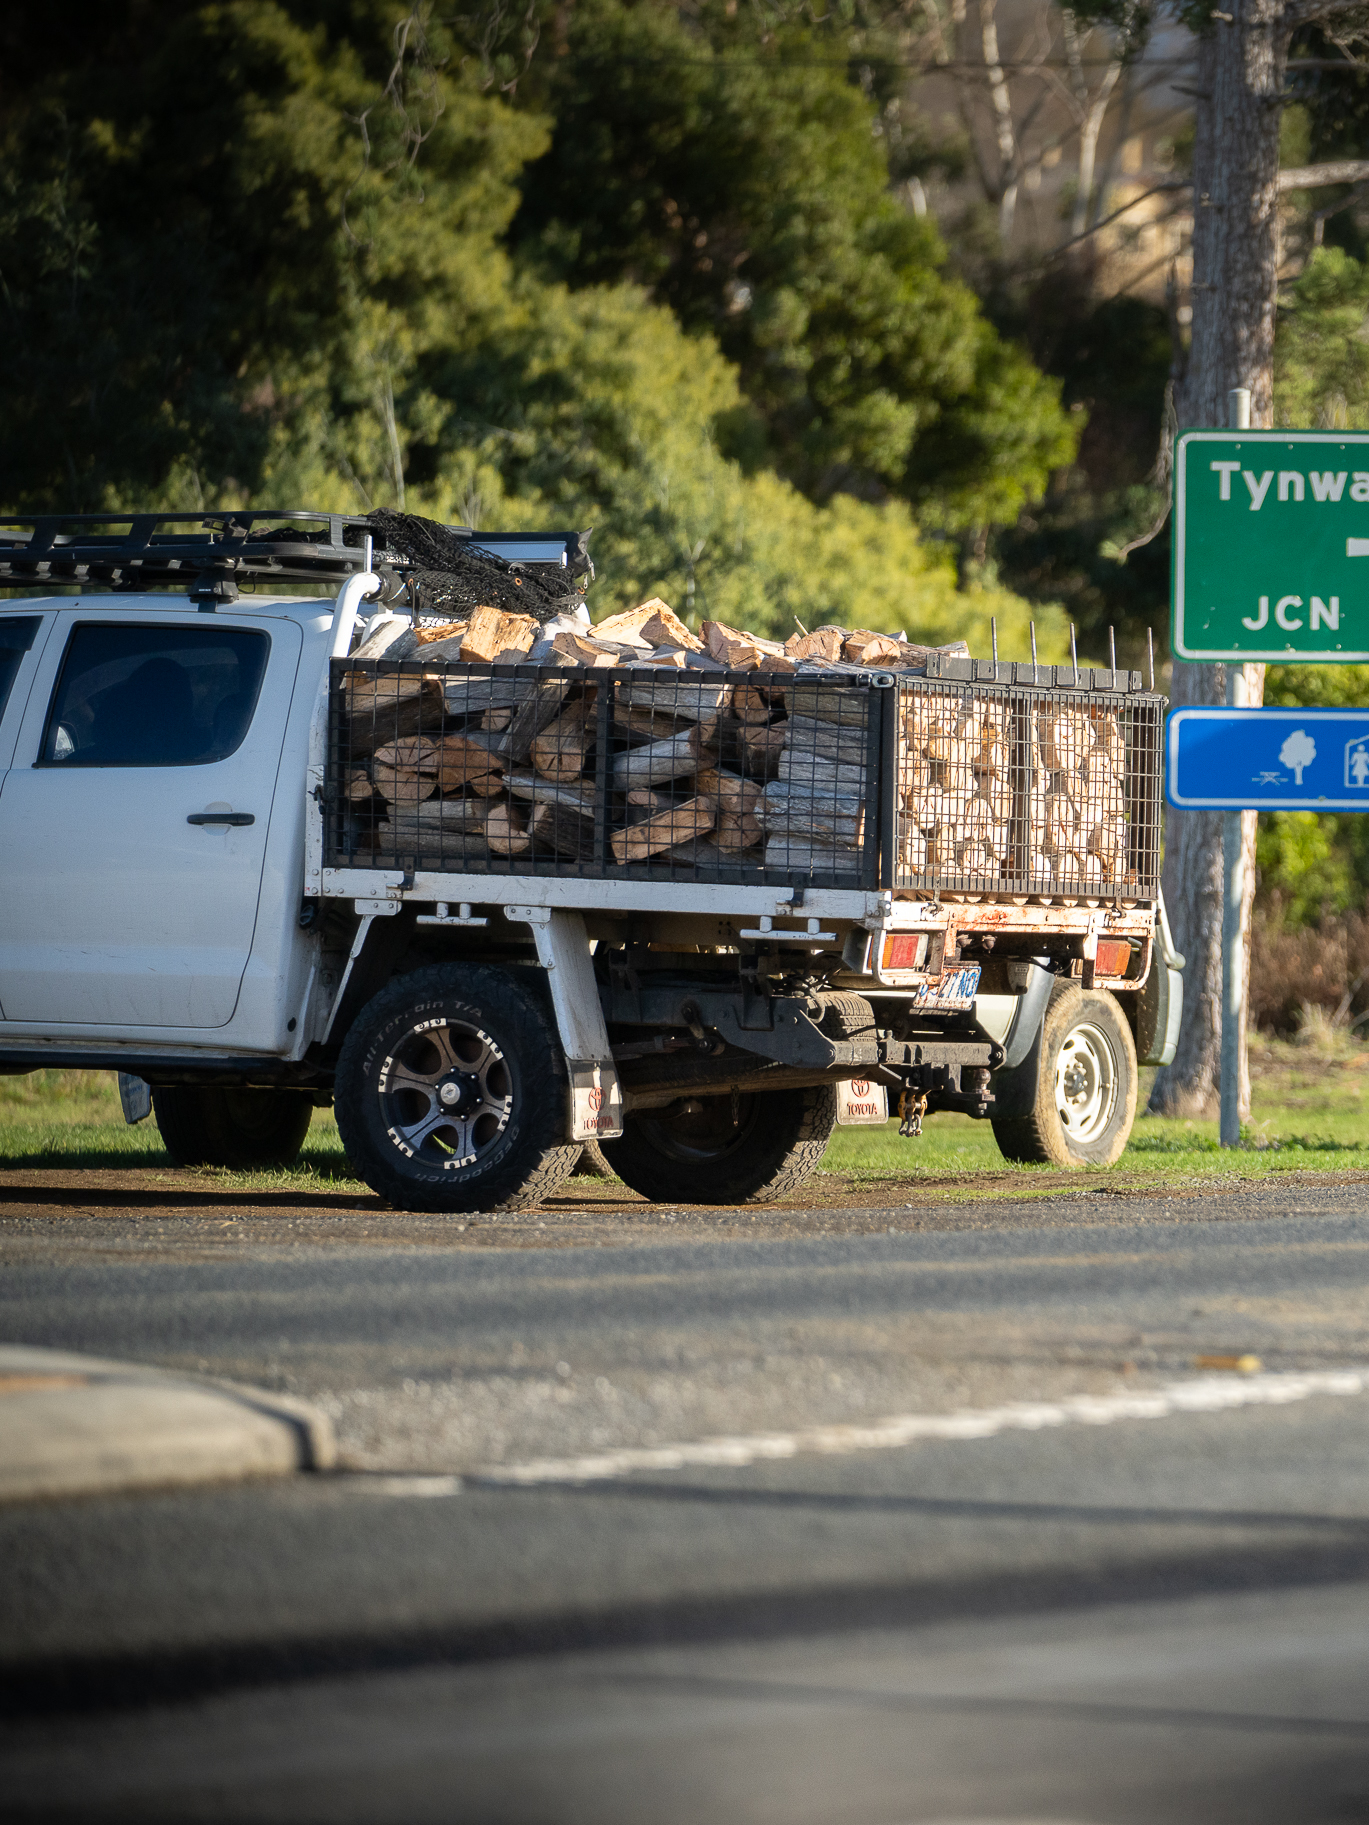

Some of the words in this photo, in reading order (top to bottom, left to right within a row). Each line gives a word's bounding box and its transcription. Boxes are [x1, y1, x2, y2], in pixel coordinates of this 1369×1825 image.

[1241, 595, 1341, 632] JCN
[846, 1102, 878, 1116] TOYOTA
[583, 1115, 614, 1131] TOYOTA
